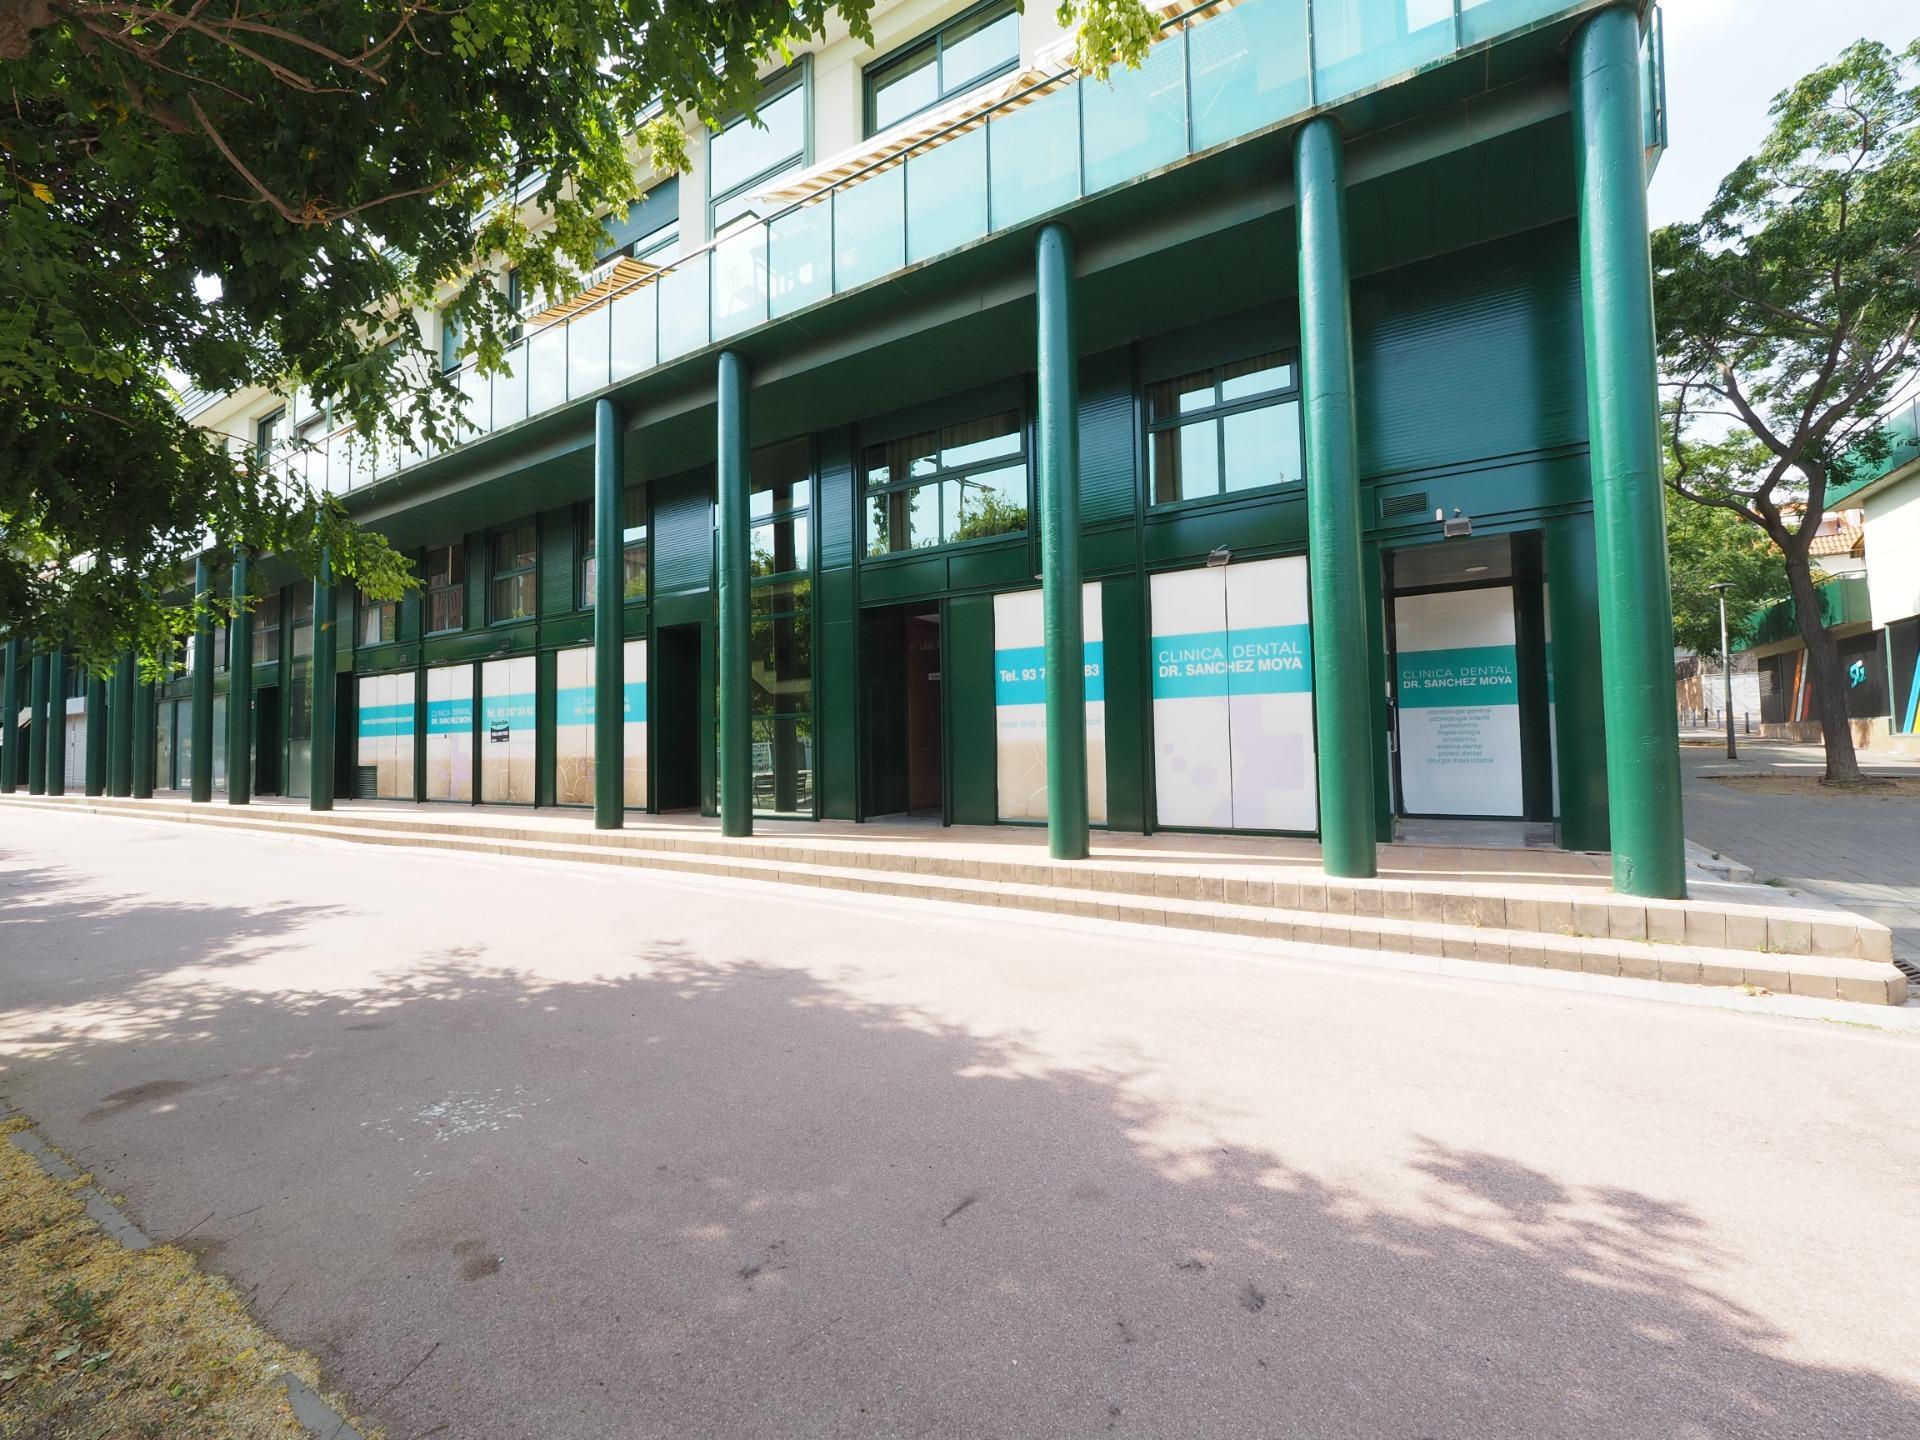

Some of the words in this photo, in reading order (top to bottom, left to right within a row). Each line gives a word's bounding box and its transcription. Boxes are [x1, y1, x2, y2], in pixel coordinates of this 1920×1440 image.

[1159, 647, 1223, 663] CLINICA
[1233, 641, 1302, 658] DENTAL
[1159, 665, 1182, 677] DR.
[1186, 660, 1254, 676] SANCHEZ
[1258, 657, 1303, 671] MOYA
[1404, 668, 1453, 679] CLINICA
[1461, 666, 1512, 676] DENTAL
[1000, 669, 1019, 682] Tel.
[1022, 668, 1036, 681] 93
[1404, 681, 1421, 689] DR.
[1424, 678, 1476, 688] SANCHEZ
[1480, 676, 1512, 685] MOYA
